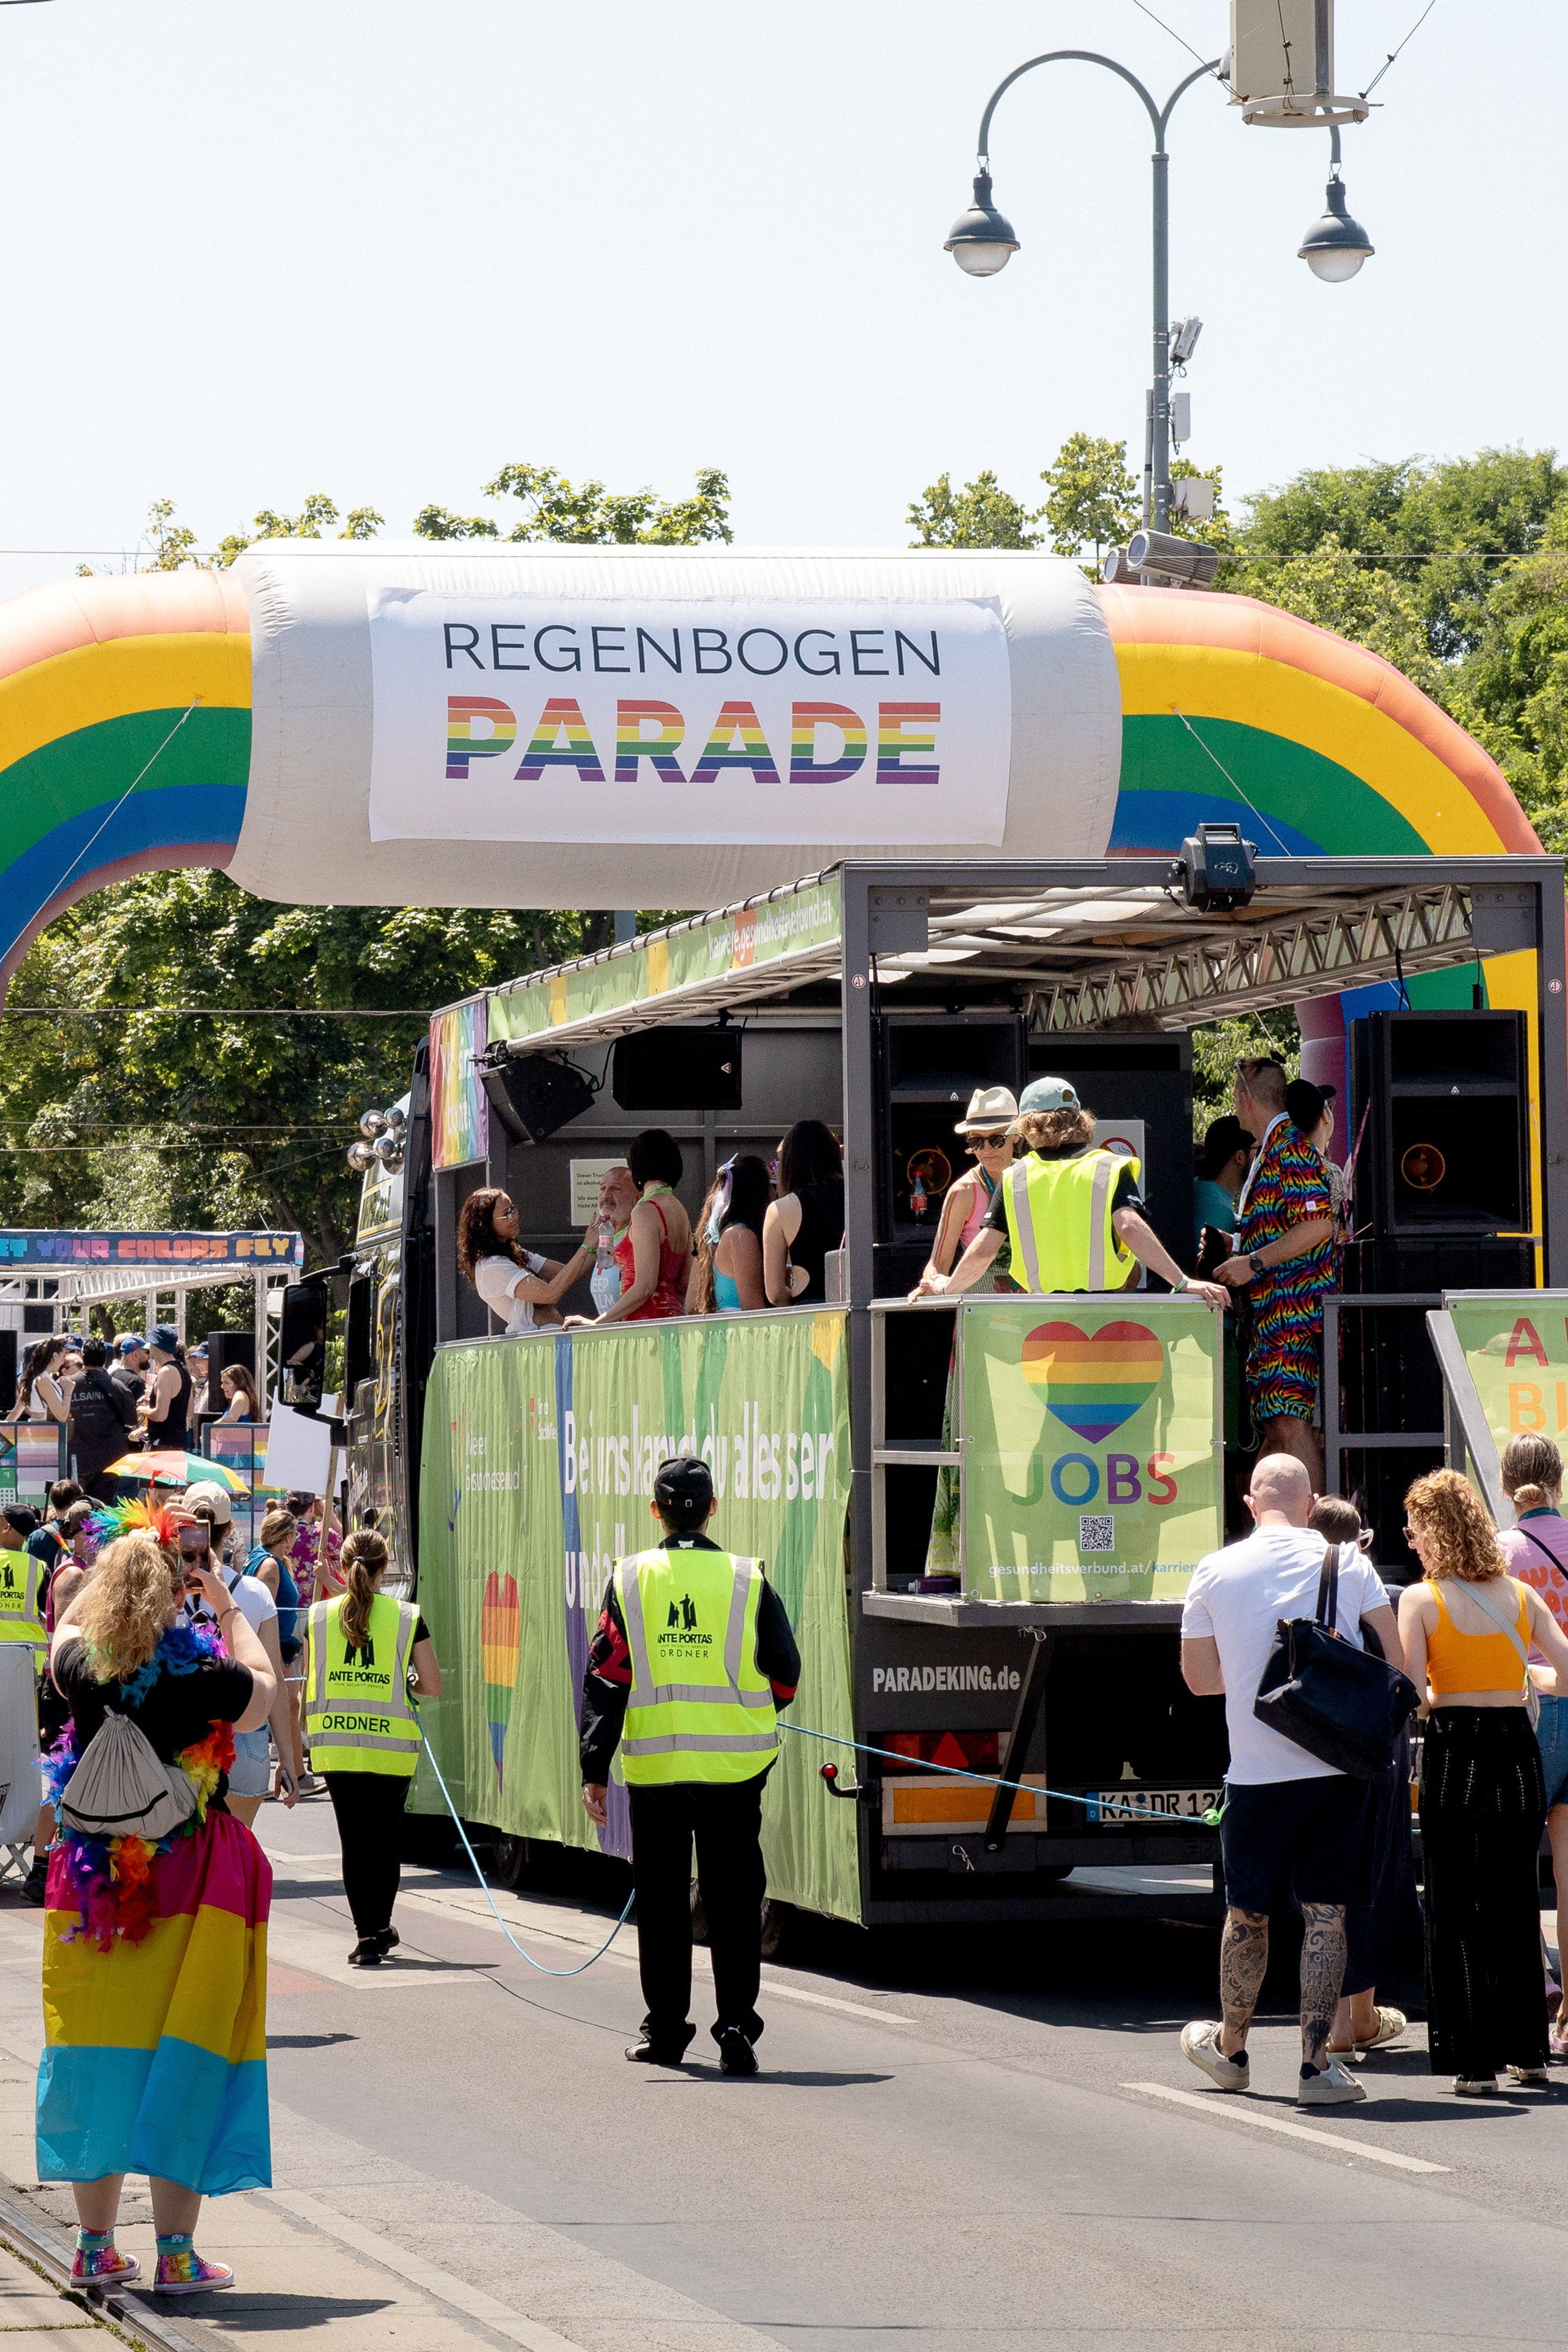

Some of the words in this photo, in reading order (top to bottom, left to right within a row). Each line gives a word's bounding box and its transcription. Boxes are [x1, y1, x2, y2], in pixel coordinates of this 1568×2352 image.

[443, 622, 941, 676] REGENBOGEN
[445, 696, 941, 785] PARADE
[37, 1238, 110, 1258] YOUR
[118, 1239, 228, 1259] COLORS
[236, 1237, 290, 1256] FLY
[735, 1401, 782, 1501] alles
[1012, 1452, 1178, 1506] JOBS
[679, 1634, 712, 1644] PORTAS
[660, 1649, 709, 1658] ORDNER
[328, 1671, 353, 1682] ANTE
[355, 1672, 390, 1685] PORTAS
[873, 1665, 1020, 1692] PARADEKING.de
[322, 1714, 390, 1734] ORDNER
[1102, 1795, 1133, 1819] KA
[1150, 1793, 1181, 1818] DR
